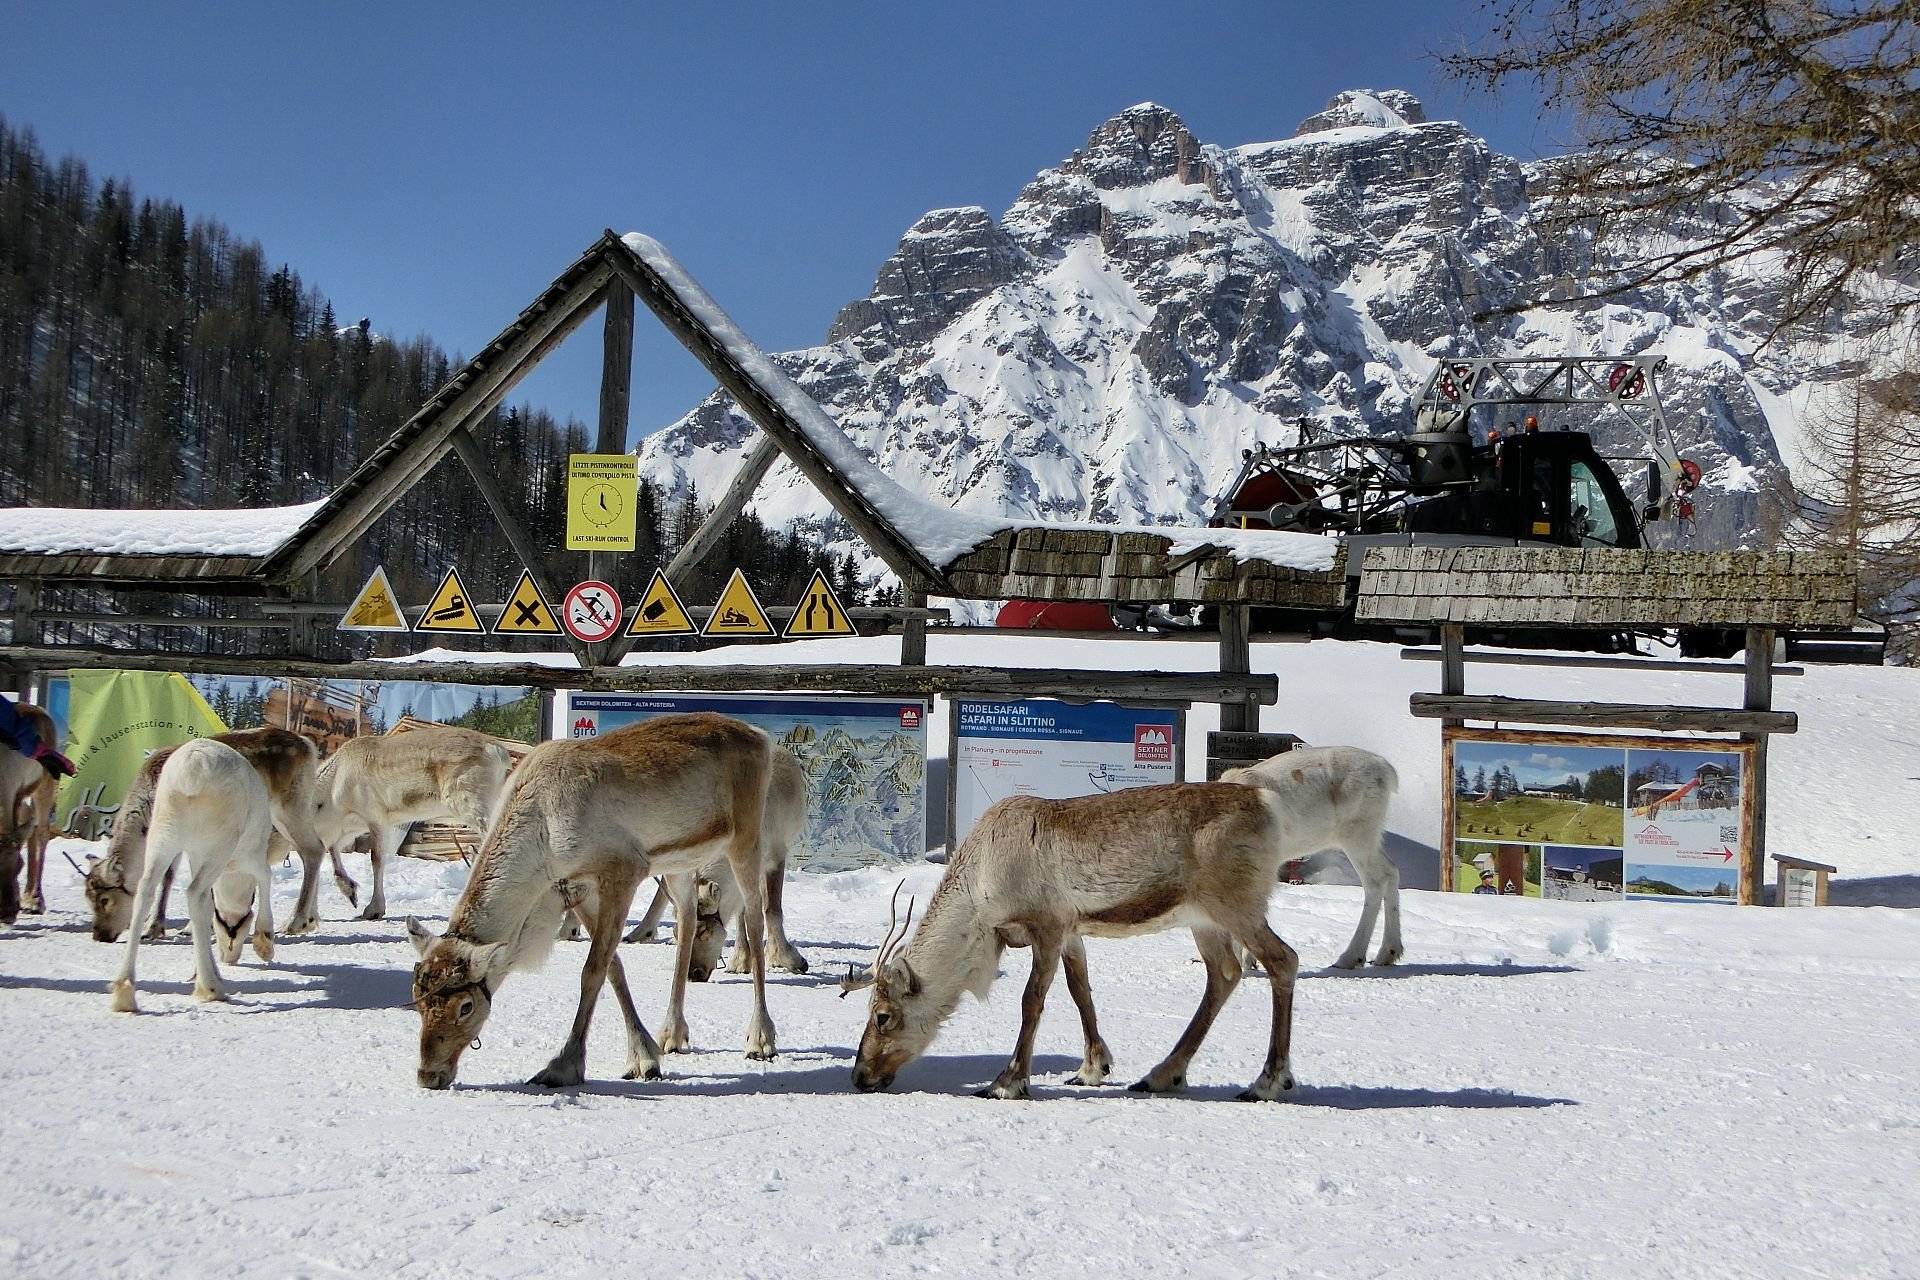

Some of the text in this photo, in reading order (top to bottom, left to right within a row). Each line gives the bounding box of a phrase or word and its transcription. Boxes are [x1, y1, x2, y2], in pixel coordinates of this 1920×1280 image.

[961, 704, 1029, 715] RODELSAFARI
[960, 715, 1055, 727] SAFARI IN SLITTINO
[100, 721, 173, 748] Jausenstation
[573, 727, 597, 738] giro
[971, 746, 994, 754] Planung
[1005, 747, 1043, 756] progettazione
